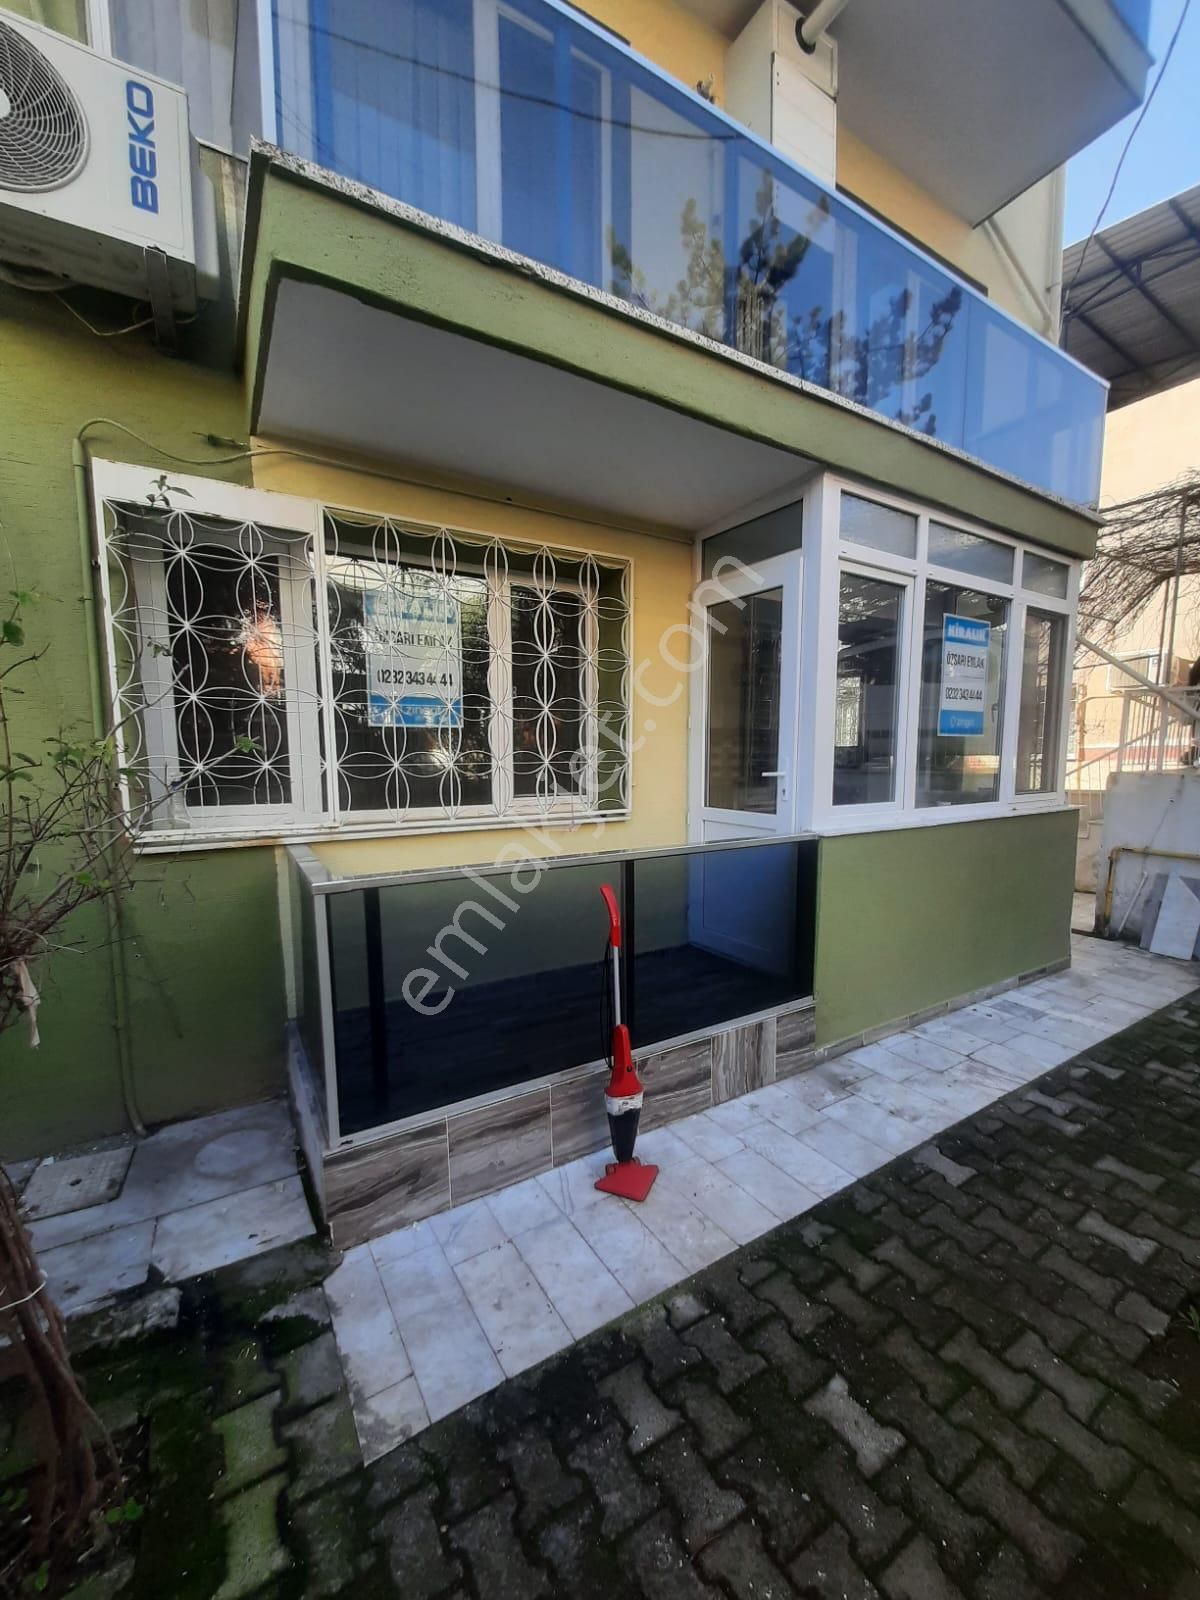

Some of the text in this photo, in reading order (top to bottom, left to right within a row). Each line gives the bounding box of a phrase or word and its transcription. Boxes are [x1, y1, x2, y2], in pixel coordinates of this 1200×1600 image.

[126, 80, 159, 214] BEKO
[377, 669, 404, 685] 0232
[405, 670, 425, 685] 343
